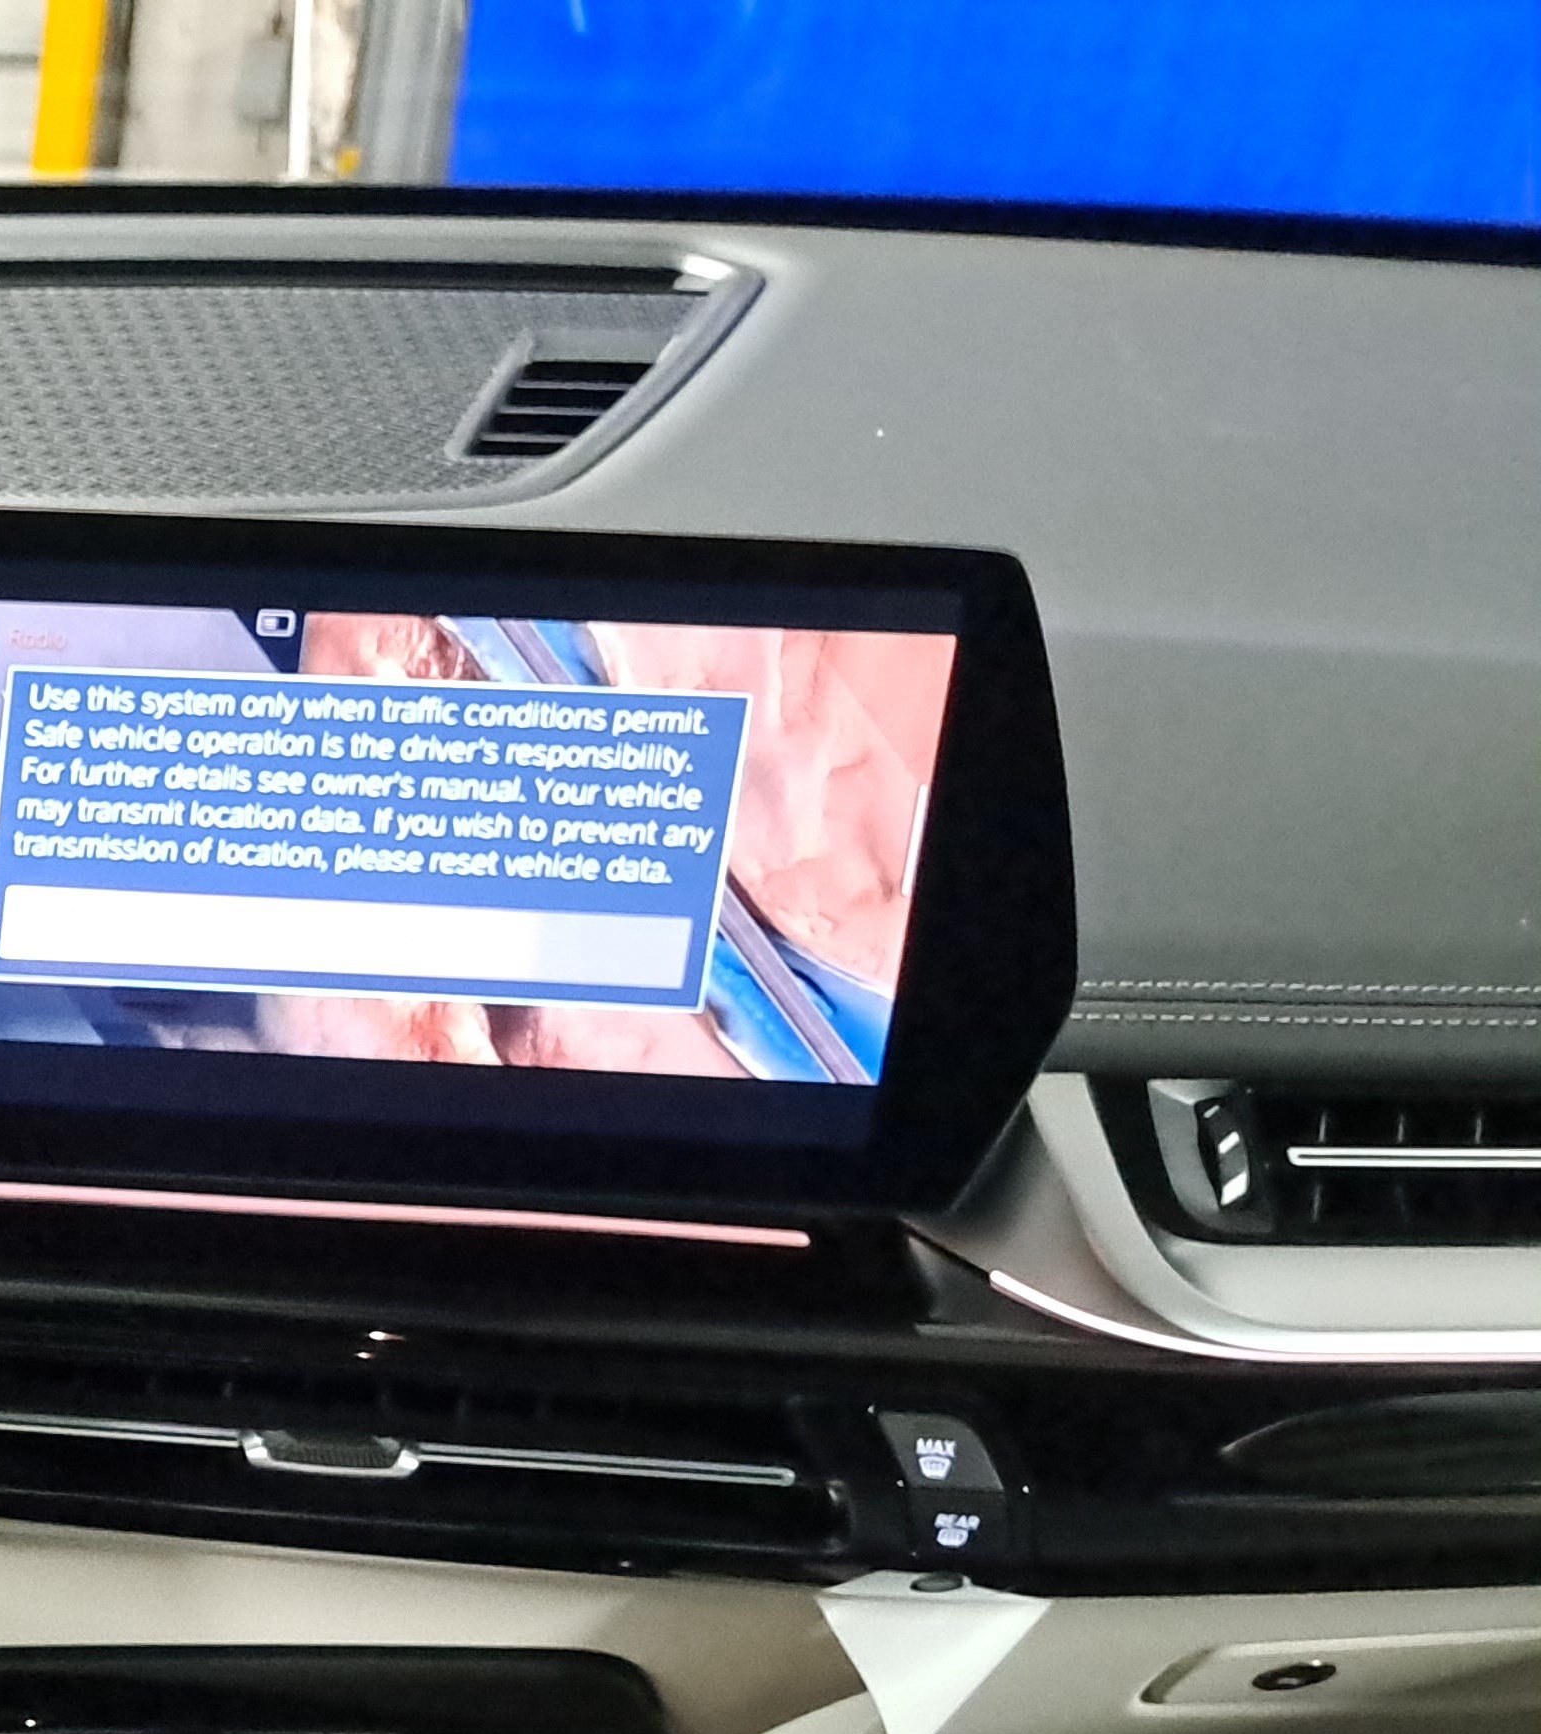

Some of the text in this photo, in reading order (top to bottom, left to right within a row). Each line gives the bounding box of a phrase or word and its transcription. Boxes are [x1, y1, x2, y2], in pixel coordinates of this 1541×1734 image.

[28, 682, 710, 737] Use this system only when traffic conditions permit.
[23, 718, 695, 778] Safe vehicle operation is the driver's responsibility.
[20, 756, 703, 811] For further details see owner's manual. Your vehicle
[16, 796, 715, 854] may transmit location data. If you wish to prevent any
[13, 831, 673, 884] transmission of location, please reset vehicle data.
[916, 1437, 956, 1458] MAX
